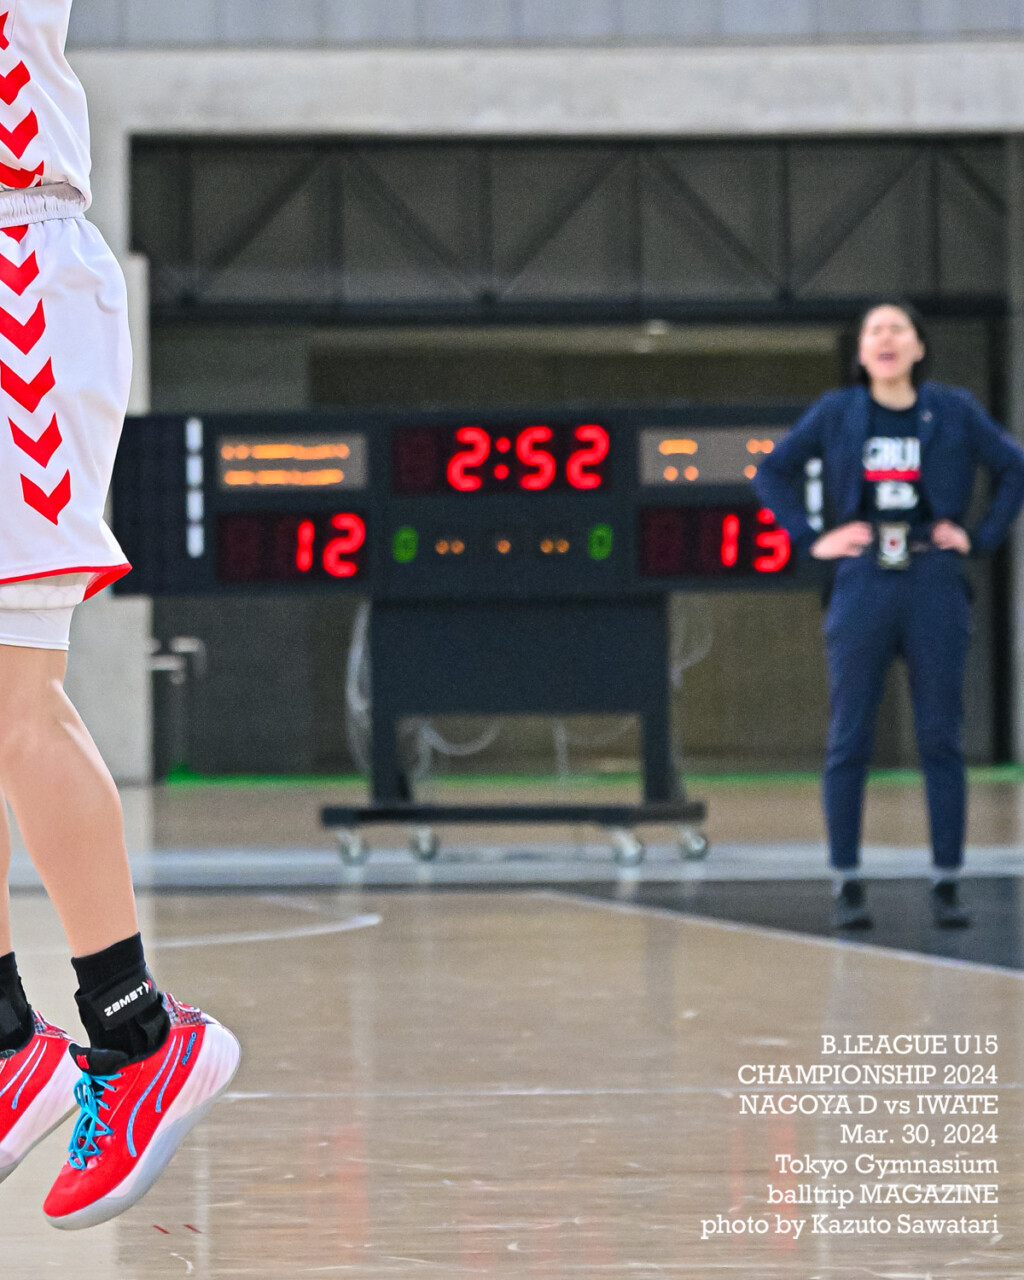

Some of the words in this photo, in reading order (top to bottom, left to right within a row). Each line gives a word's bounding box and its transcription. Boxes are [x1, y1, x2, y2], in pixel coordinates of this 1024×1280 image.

[446, 424, 610, 492] 2:52
[295, 512, 367, 578] 12
[720, 506, 792, 573] 13
